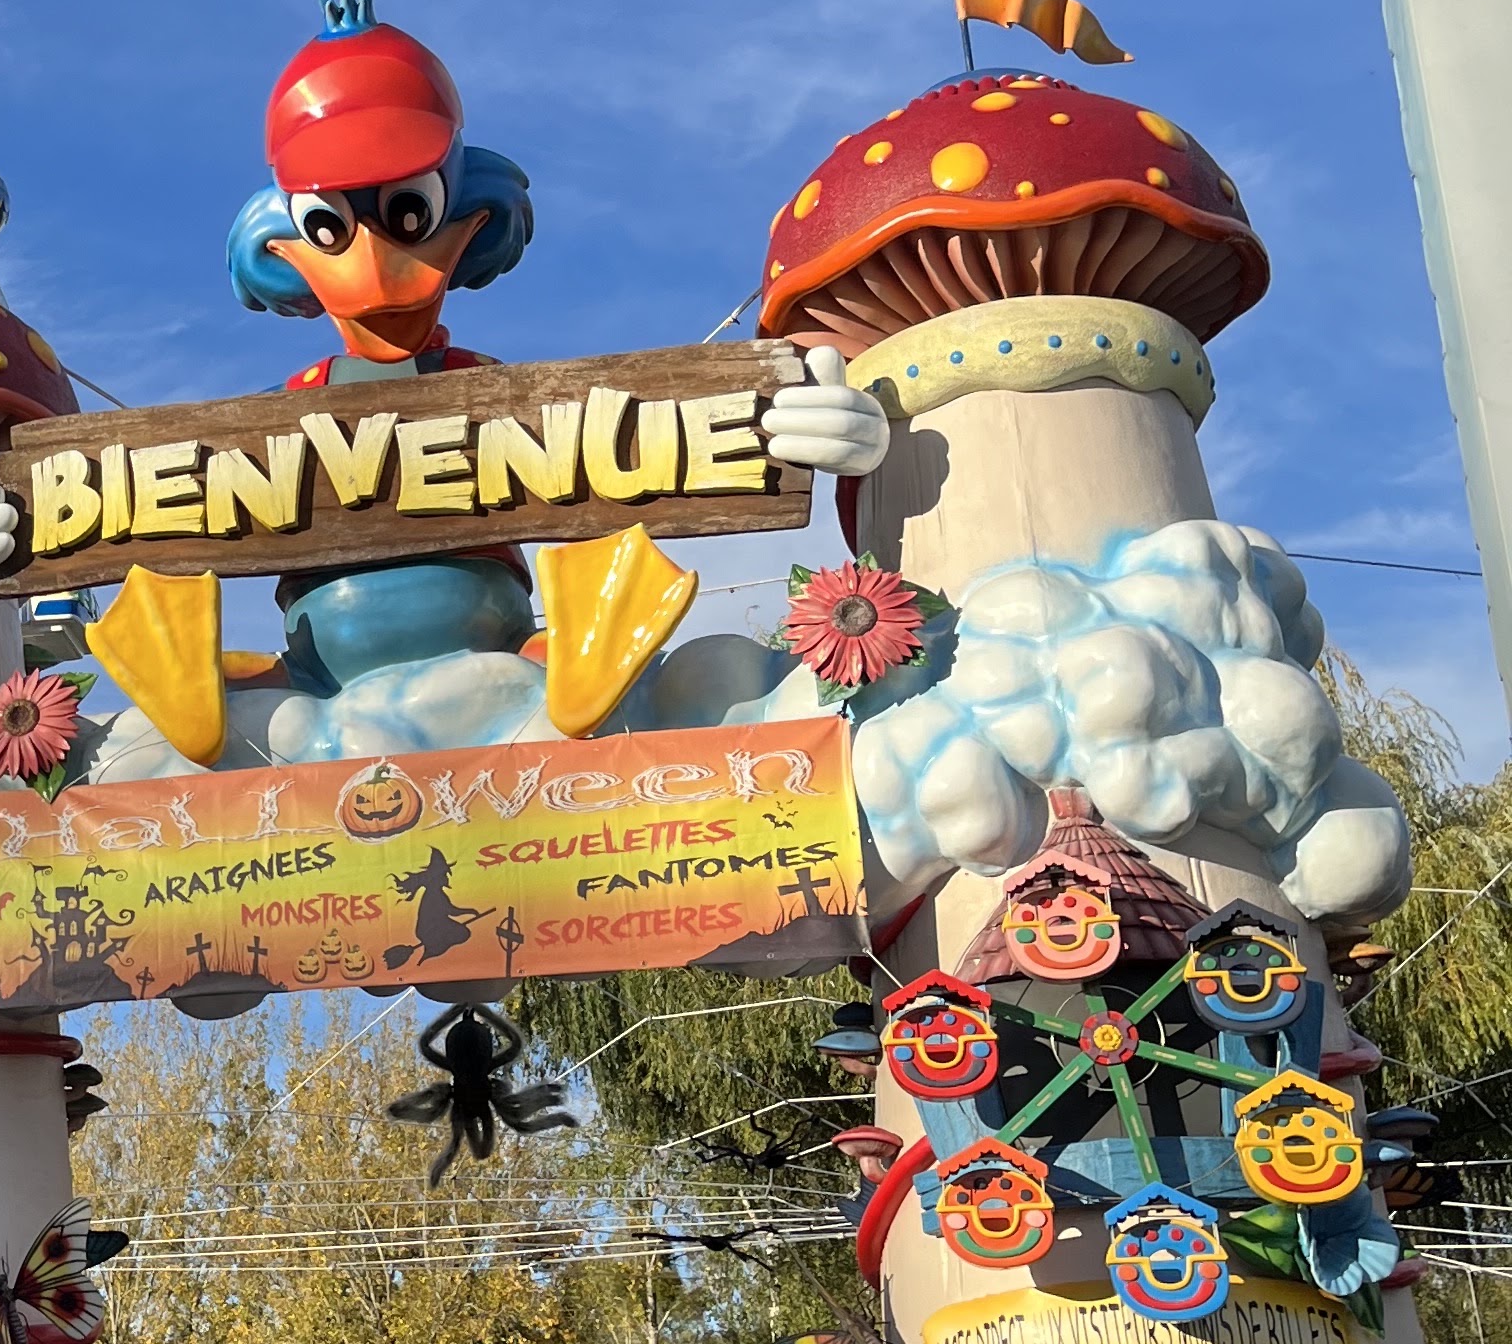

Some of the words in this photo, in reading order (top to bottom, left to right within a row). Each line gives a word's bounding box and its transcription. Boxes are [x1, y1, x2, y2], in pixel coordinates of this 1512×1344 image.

[32, 386, 767, 555] BIENVENUE
[476, 818, 737, 870] SQUELETTES
[577, 841, 838, 900] FANTOMES
[143, 841, 337, 909] ARAIGNEES
[240, 893, 383, 929] MONSTRES
[535, 901, 743, 946] SORCIERES
